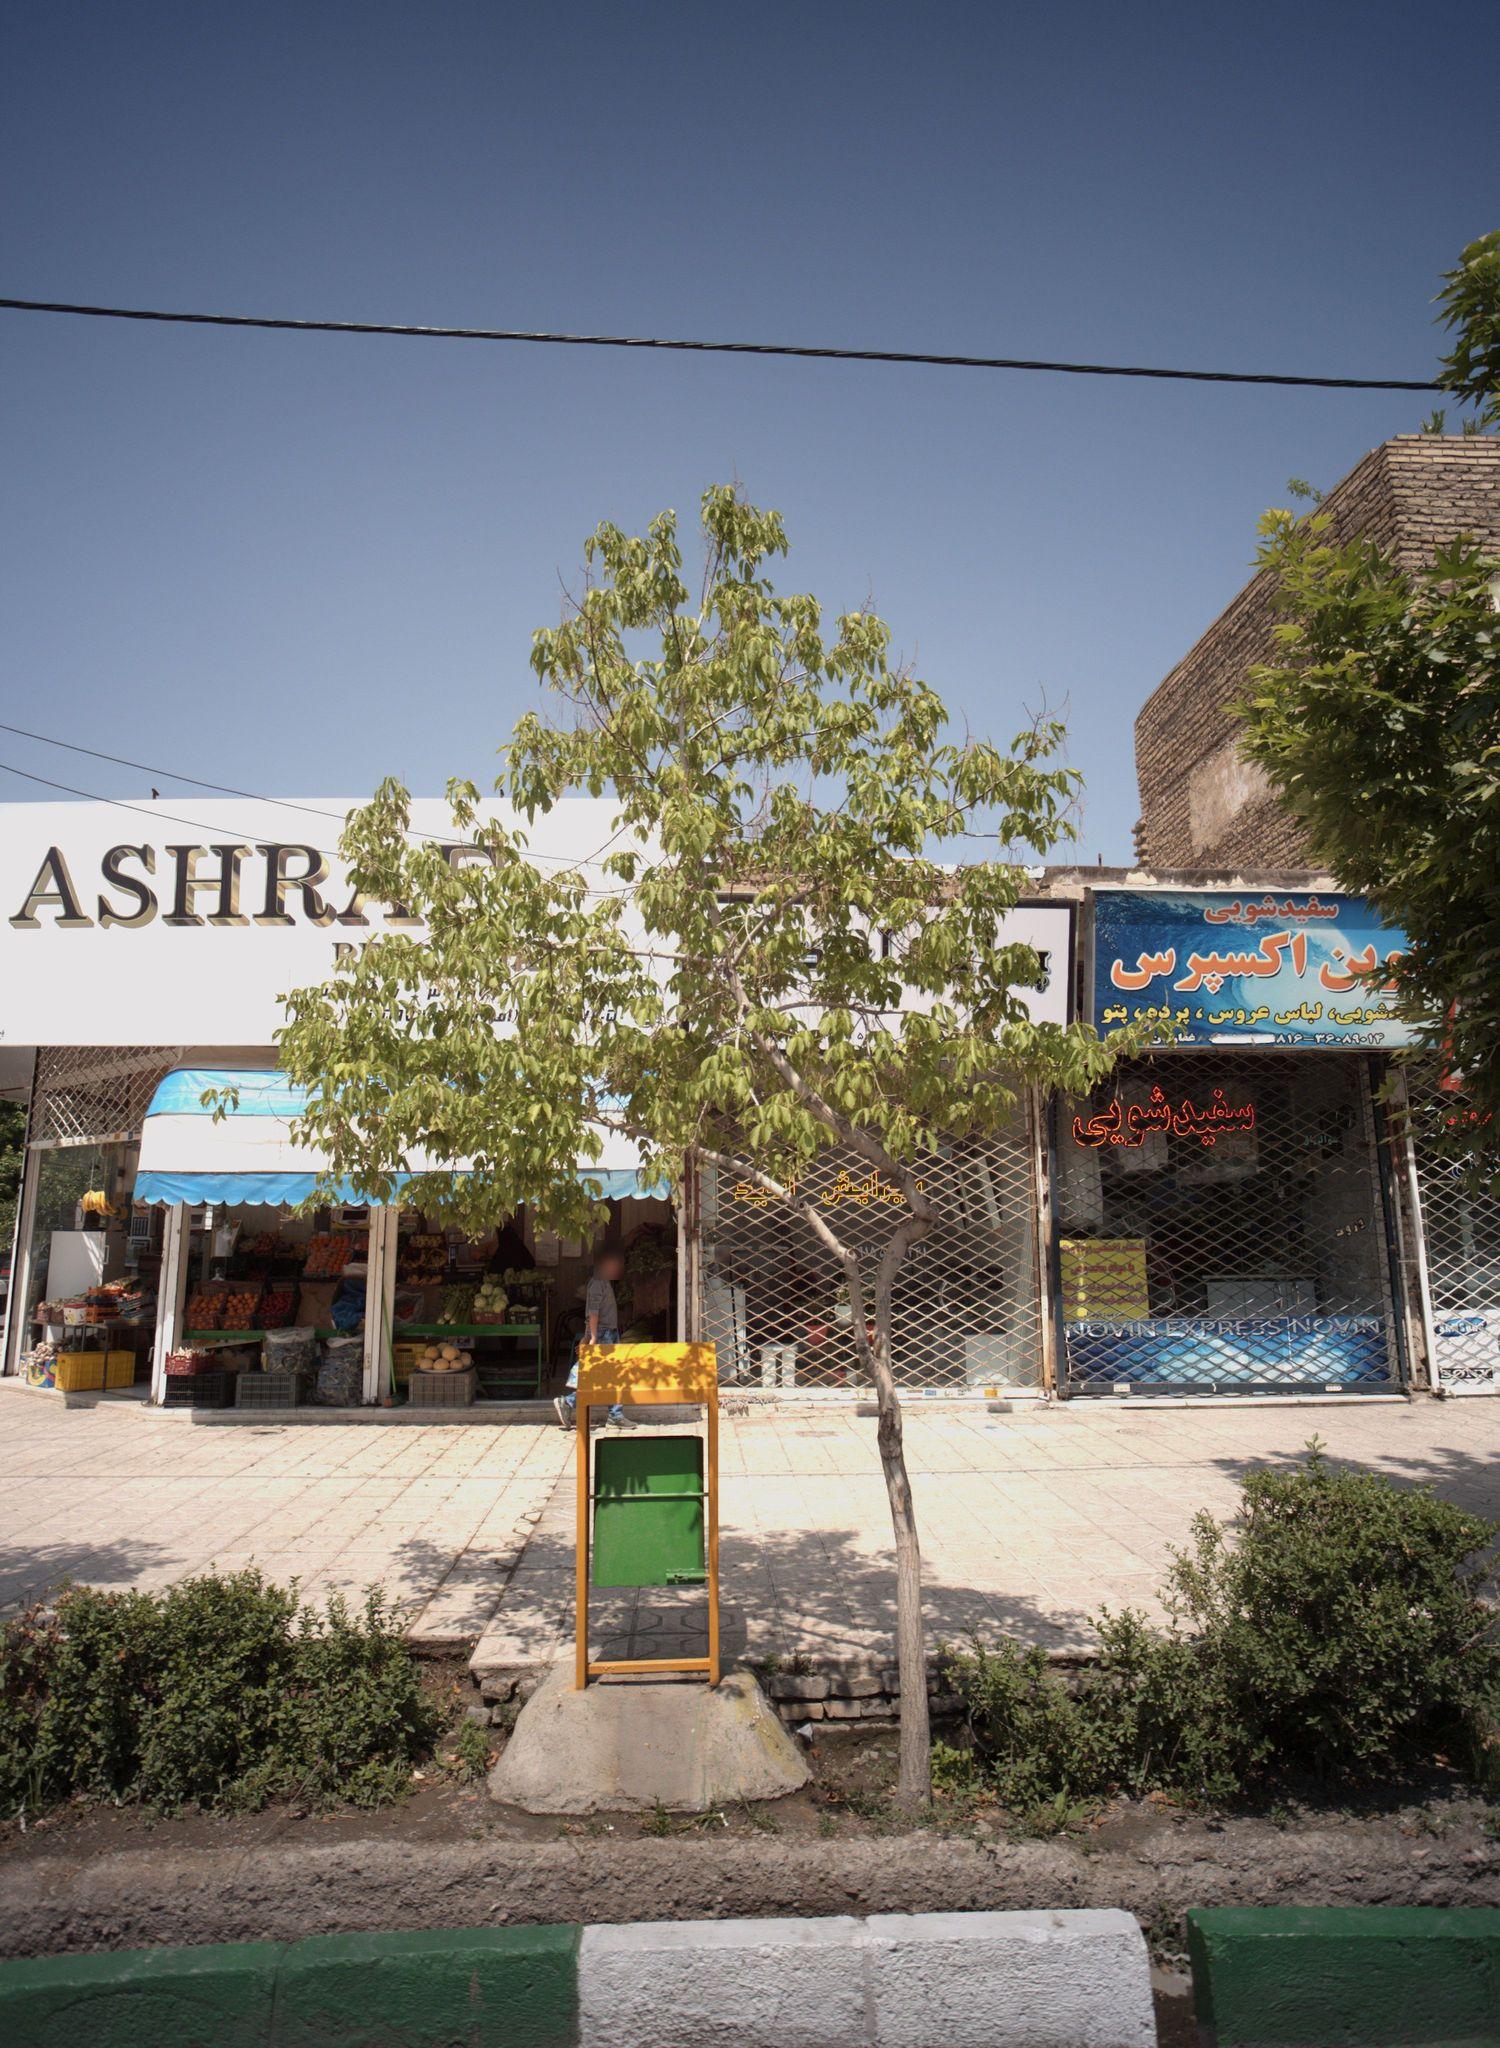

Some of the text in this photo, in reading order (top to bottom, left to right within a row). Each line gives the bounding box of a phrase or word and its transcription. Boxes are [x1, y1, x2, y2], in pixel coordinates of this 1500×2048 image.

[1110, 930, 1308, 994] اکسپرس
[1100, 1003, 1128, 1025] پتو
[1273, 1001, 1323, 1026] لباس
[1065, 1320, 1282, 1338] NOVIN EXPRESS
[1291, 1317, 1381, 1334] NOVIN
